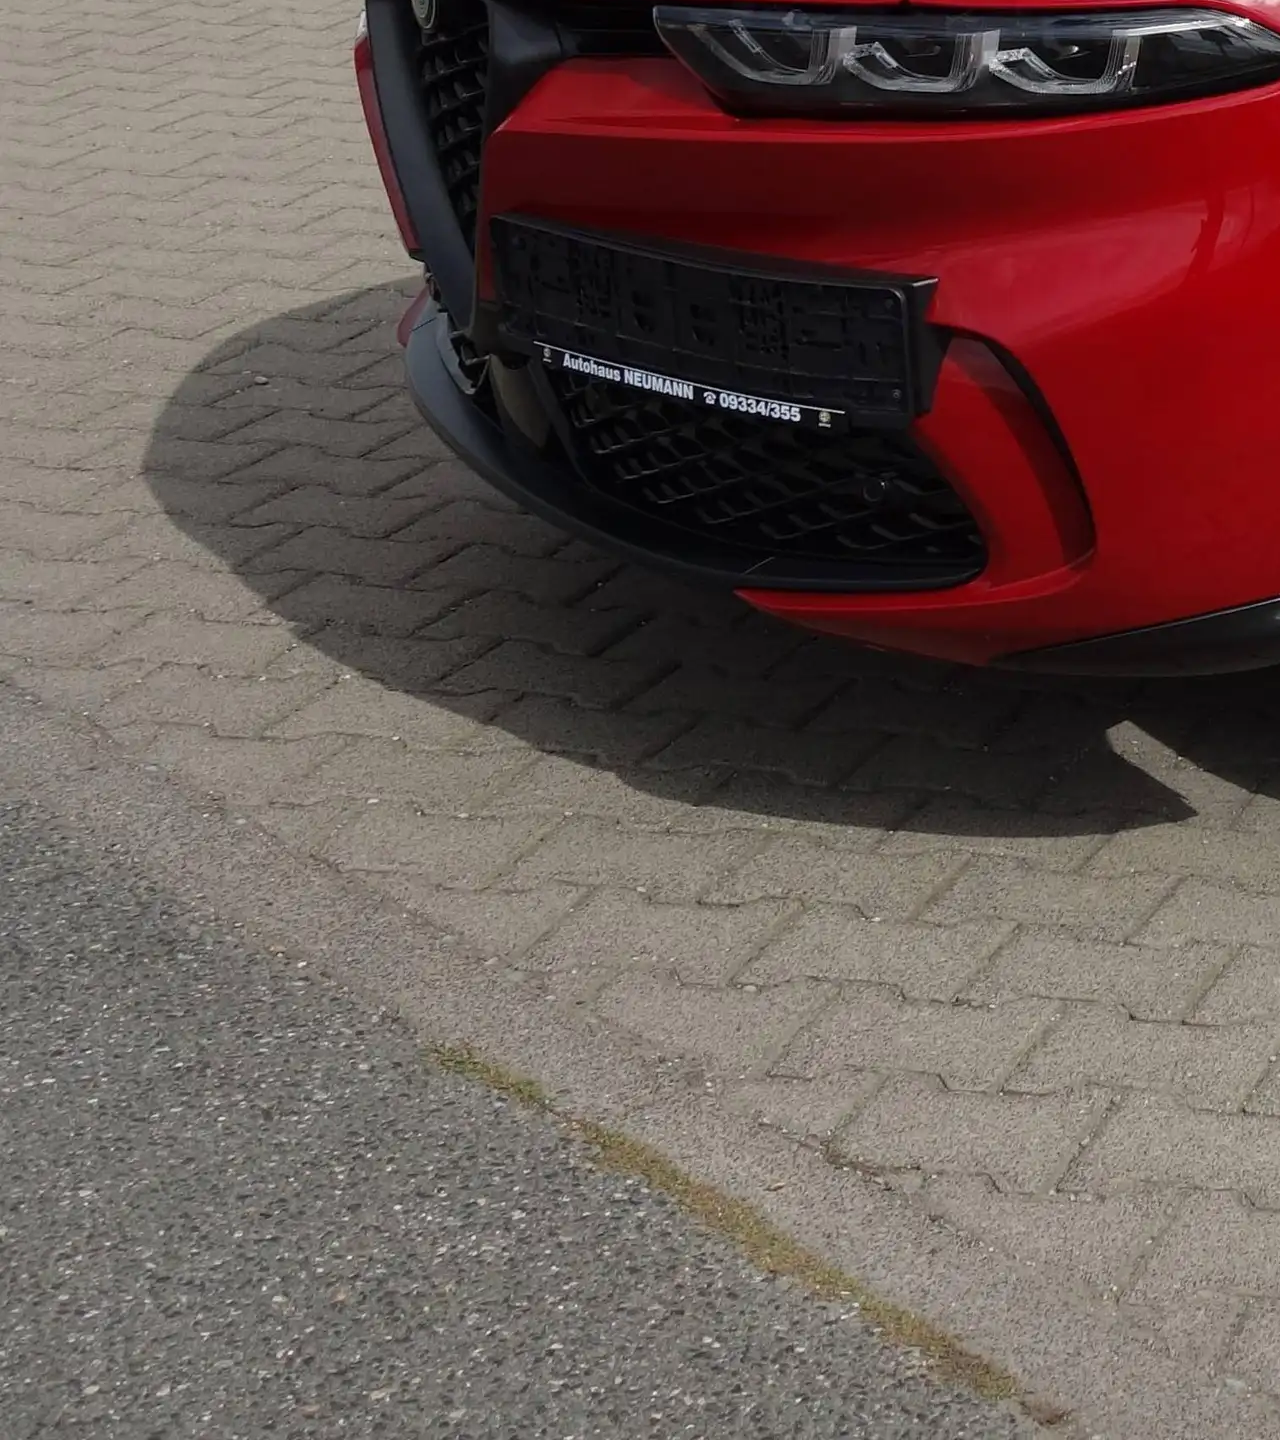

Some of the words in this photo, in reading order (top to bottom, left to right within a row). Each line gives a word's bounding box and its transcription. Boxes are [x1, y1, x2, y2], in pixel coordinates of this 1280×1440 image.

[562, 352, 621, 382] Autohaus
[623, 369, 695, 400] NEUMANN
[719, 392, 801, 423] 09334/355
